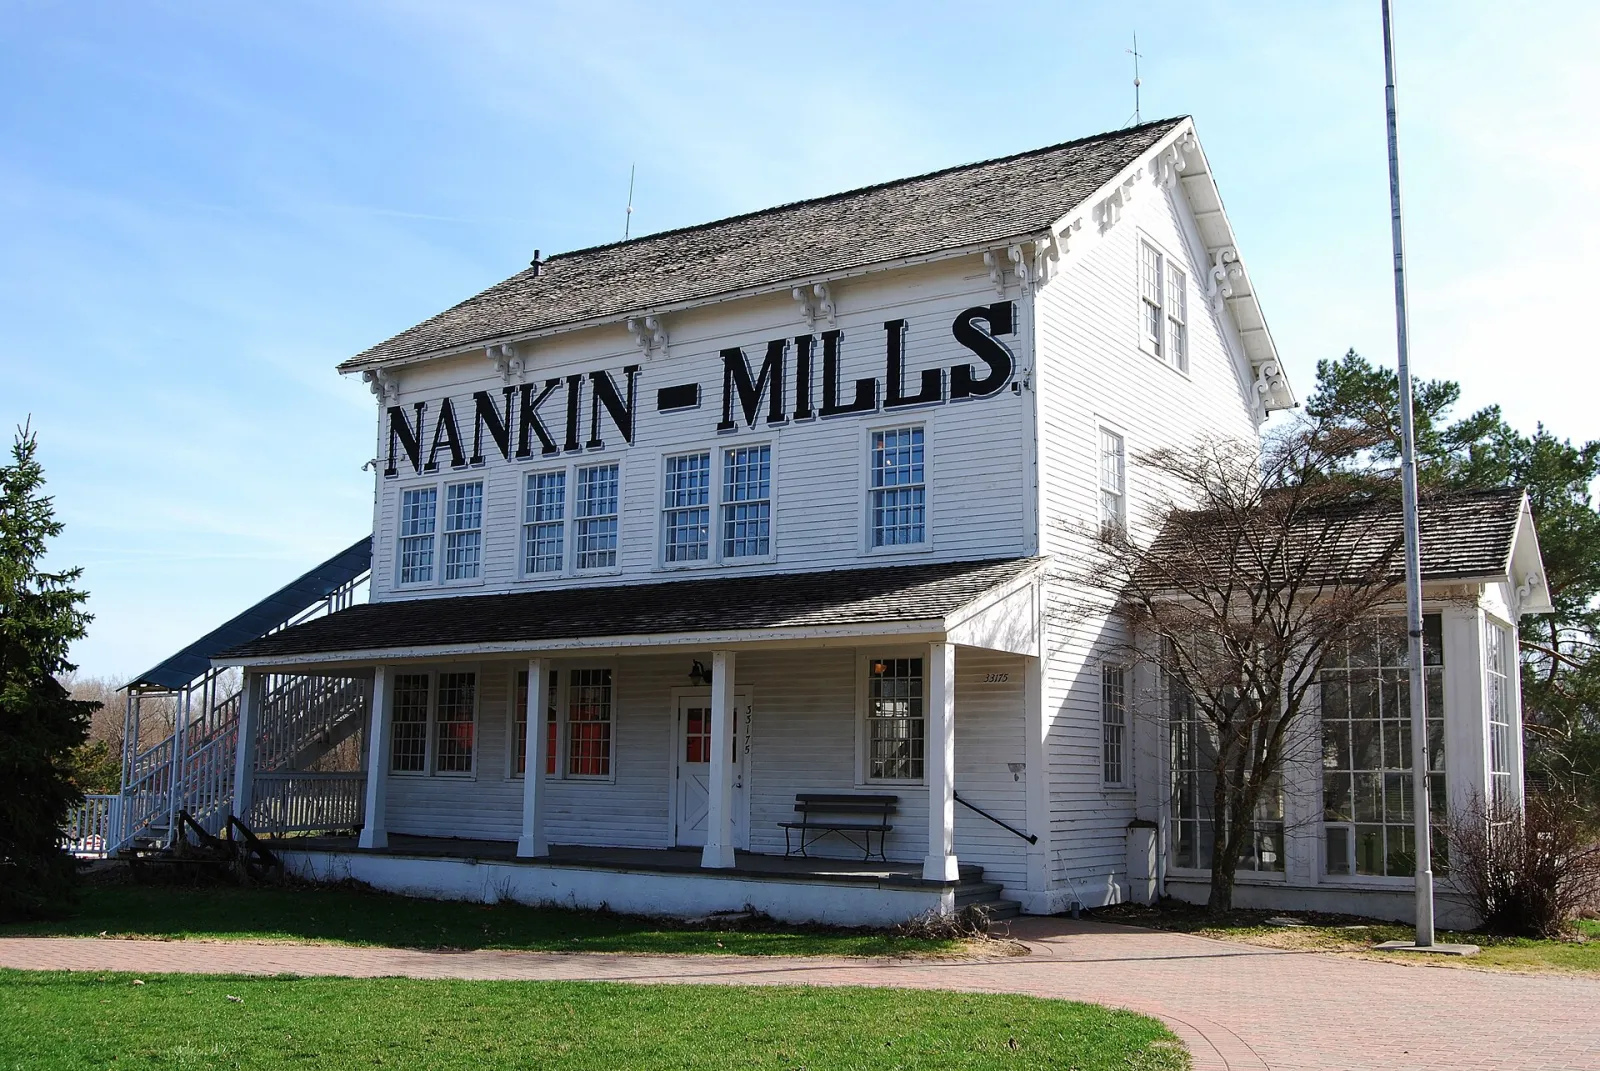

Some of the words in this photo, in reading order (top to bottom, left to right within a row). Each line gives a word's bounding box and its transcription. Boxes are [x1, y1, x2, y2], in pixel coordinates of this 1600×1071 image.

[385, 364, 641, 478] NANKIN
[983, 673, 1009, 683] 33175
[744, 704, 752, 755] 33175
